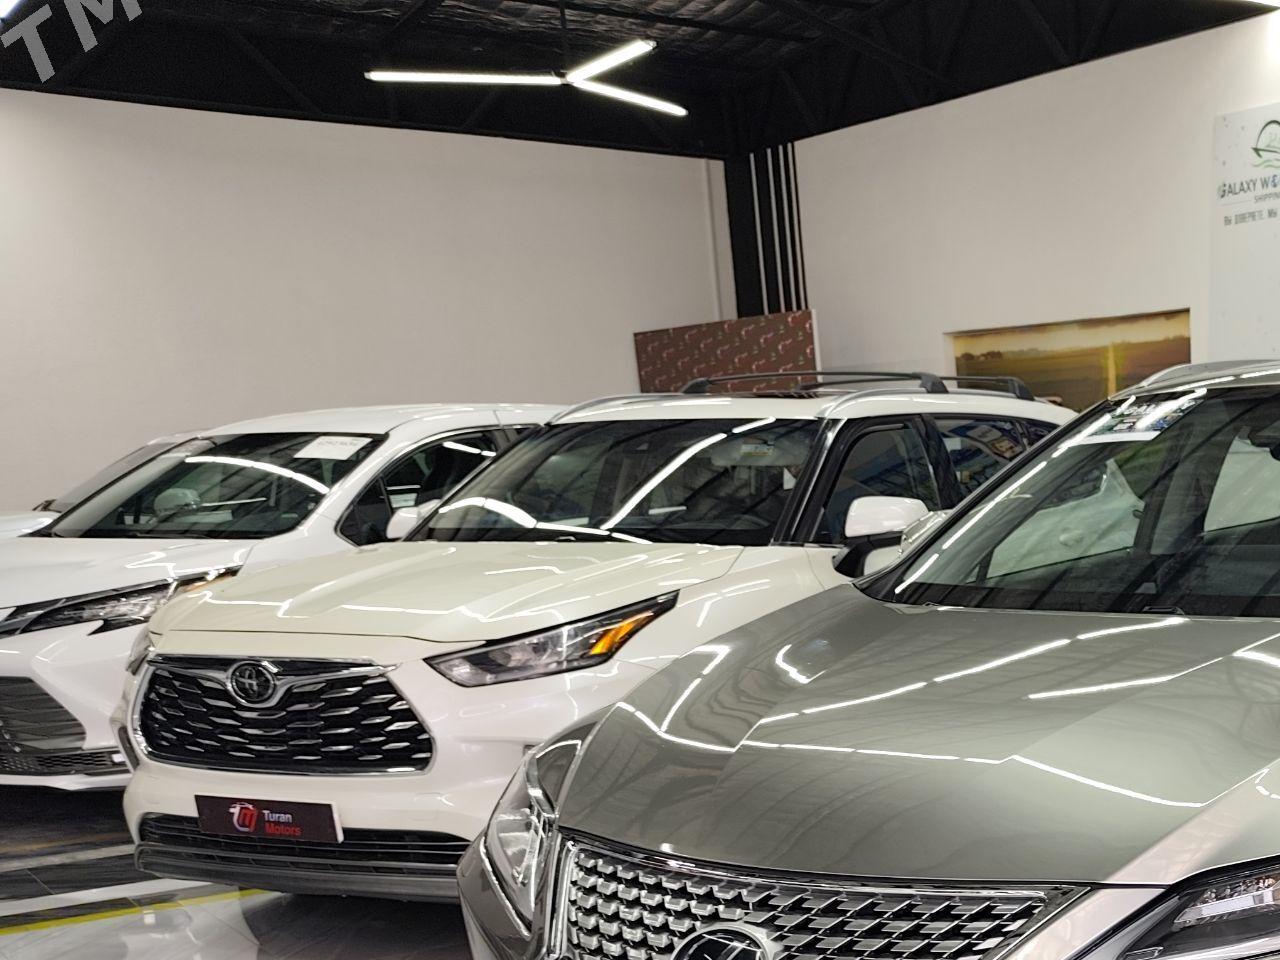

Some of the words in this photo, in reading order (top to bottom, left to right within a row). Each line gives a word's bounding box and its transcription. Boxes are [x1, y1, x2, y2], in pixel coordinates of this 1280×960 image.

[1217, 178, 1257, 199] GALAXY
[262, 809, 293, 823] Turan
[265, 823, 302, 836] Motors
